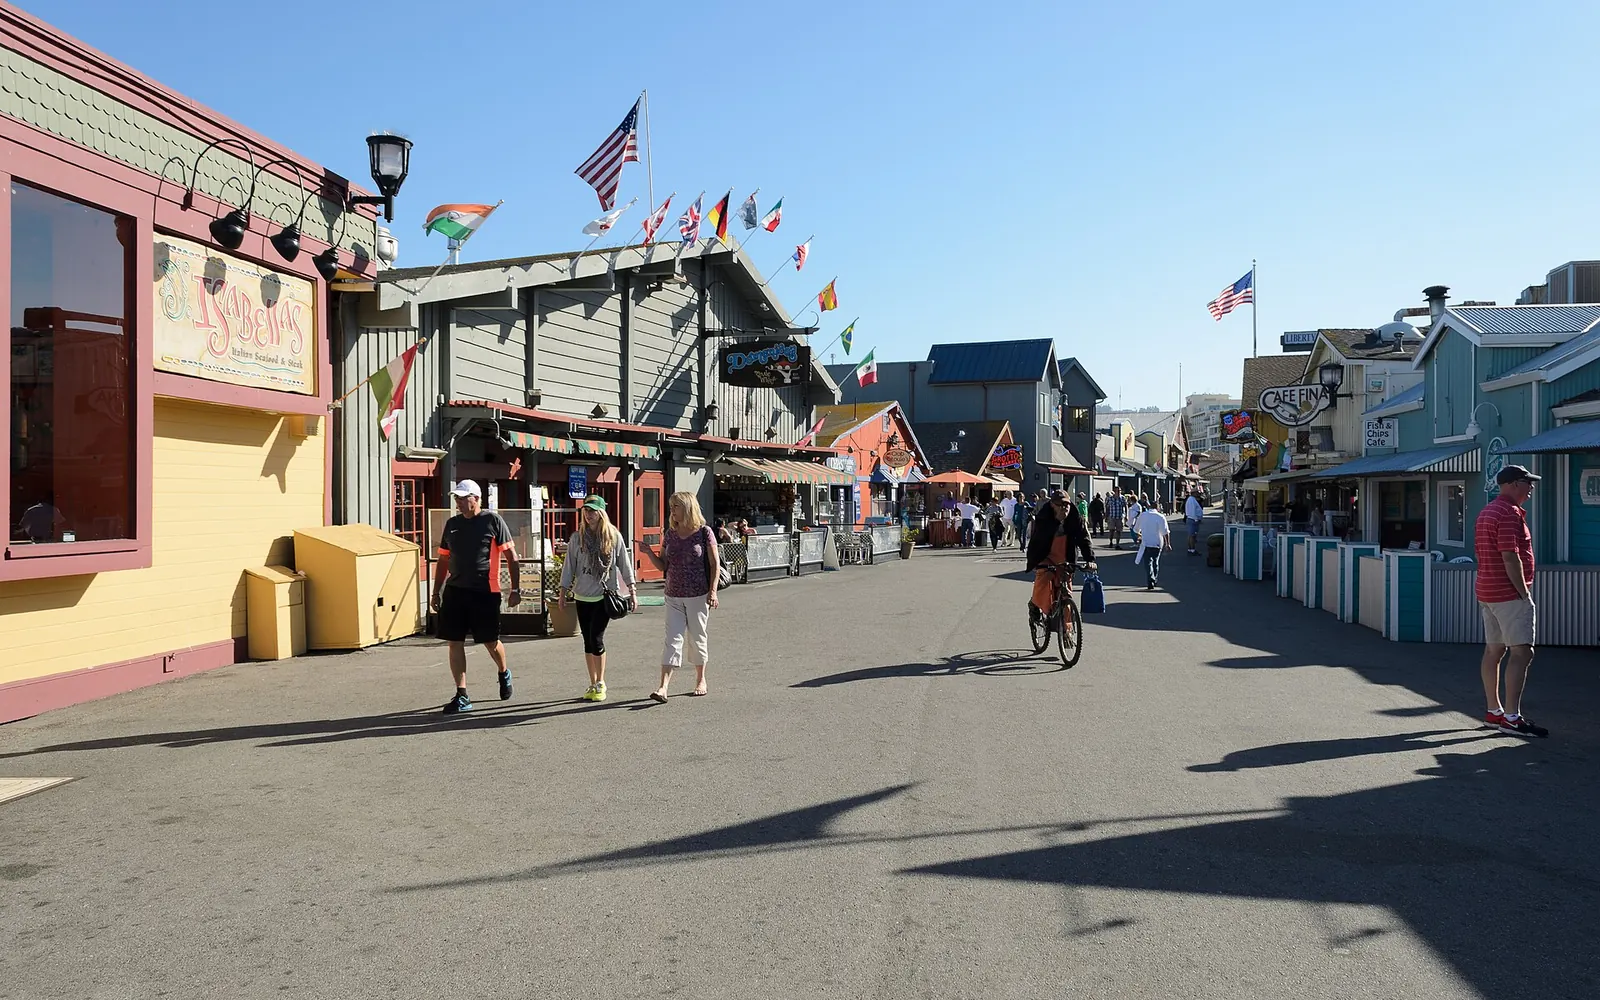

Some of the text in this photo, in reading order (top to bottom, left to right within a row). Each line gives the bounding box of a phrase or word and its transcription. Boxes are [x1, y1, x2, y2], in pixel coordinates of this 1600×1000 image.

[1285, 333, 1316, 343] LIBERTY
[231, 347, 253, 359] Italian
[1262, 387, 1329, 409] CAFE FINA
[1367, 421, 1393, 430] Fish &
[1366, 429, 1390, 438] Chips
[1366, 438, 1386, 447] Cafe
[992, 452, 1019, 462] GROTTO
